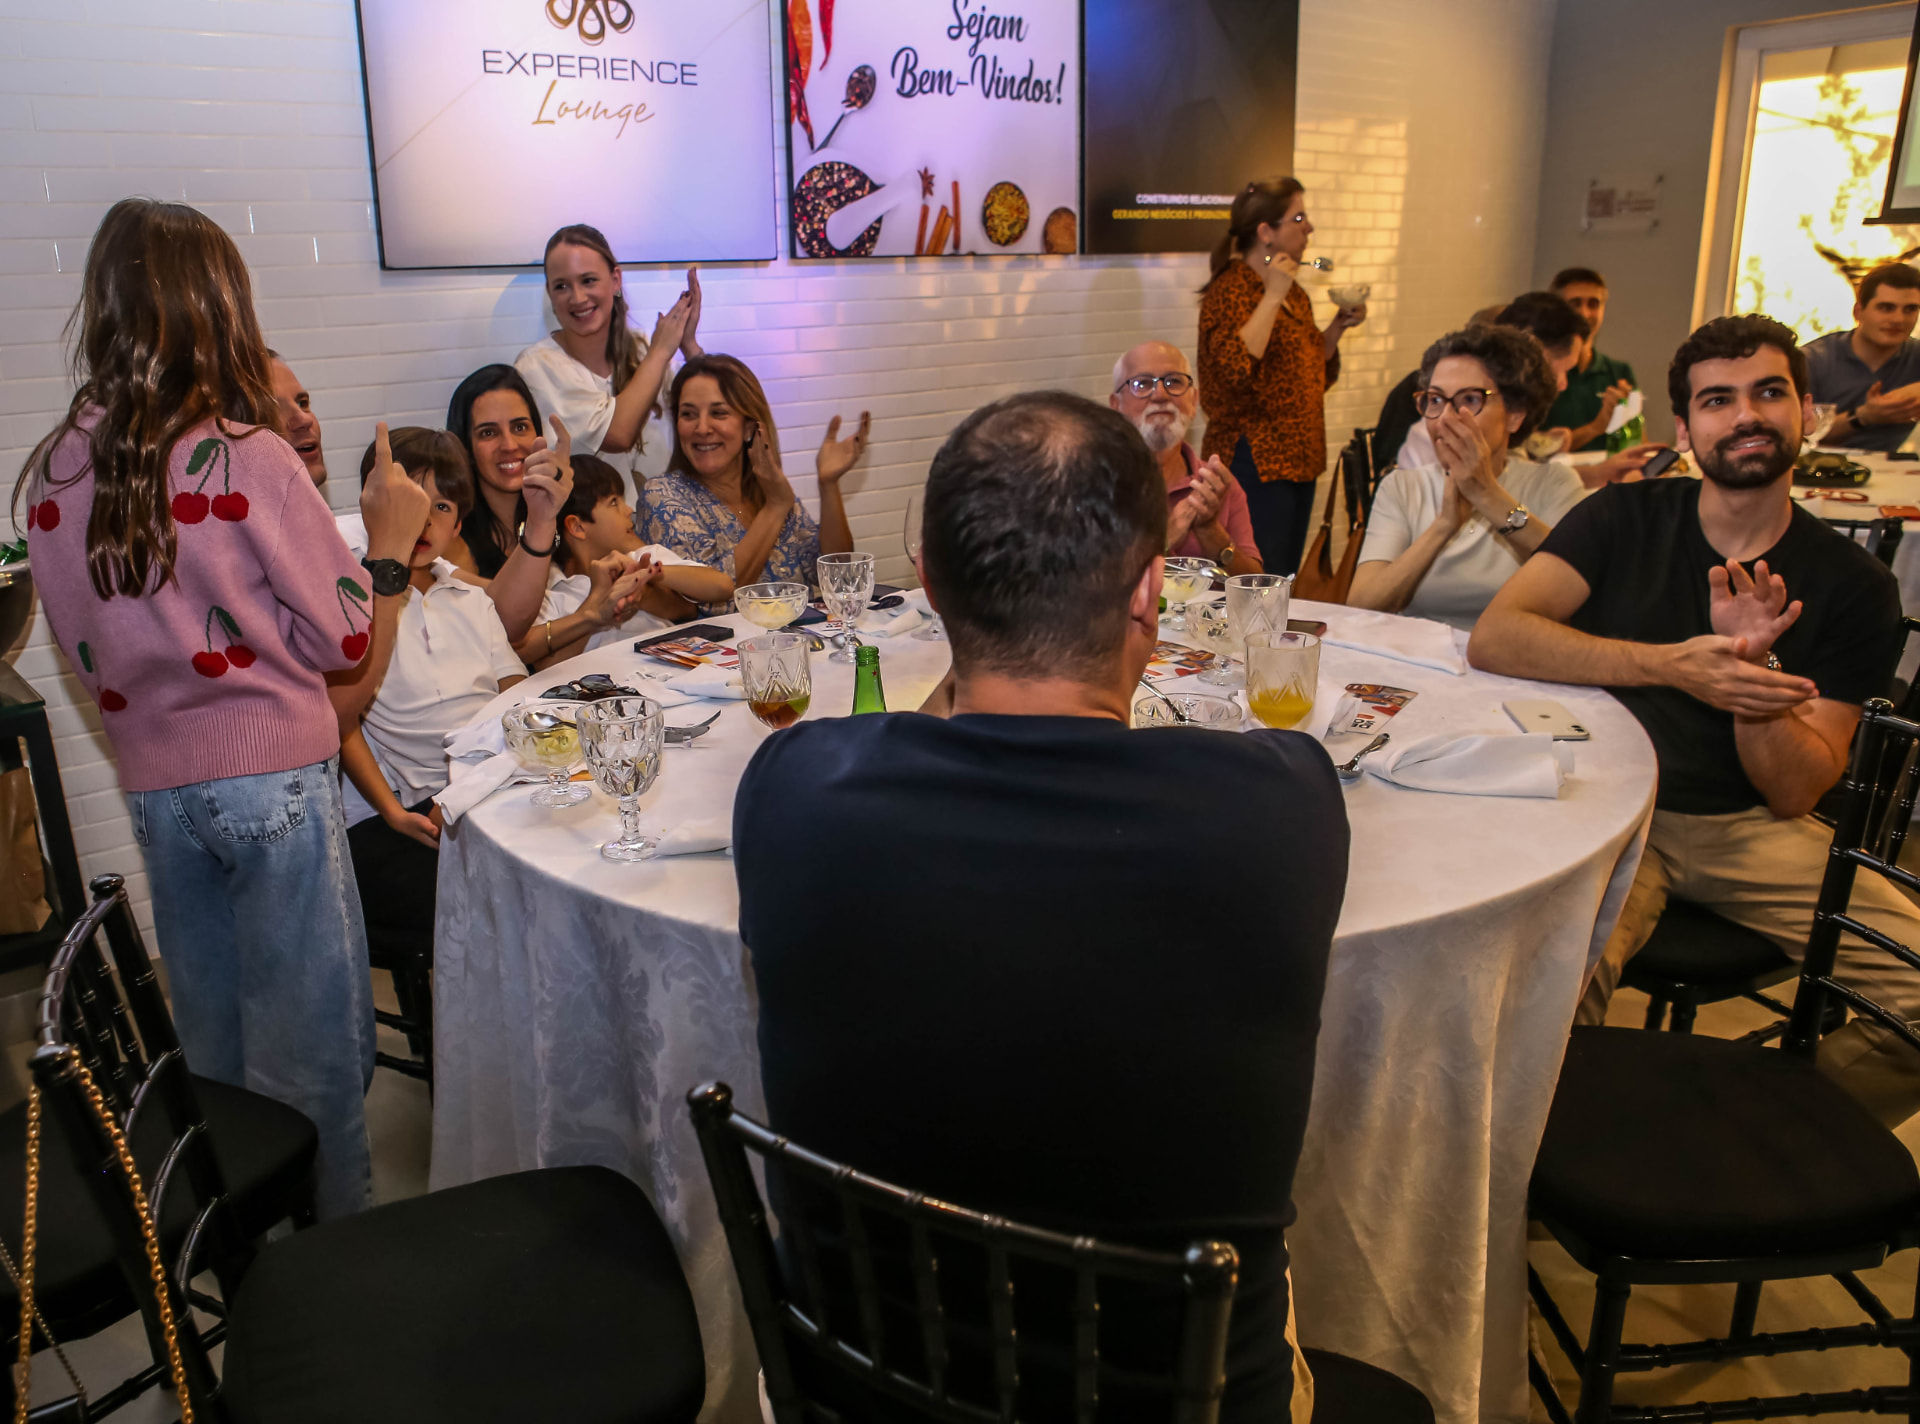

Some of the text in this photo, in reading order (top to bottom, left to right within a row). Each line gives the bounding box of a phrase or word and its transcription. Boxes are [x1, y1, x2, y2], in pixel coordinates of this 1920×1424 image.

[947, 0, 1030, 57] Sejam
[482, 50, 698, 86] EXPERIENCE
[890, 46, 1066, 105] Bem-Vindos!
[532, 79, 656, 140] Lounge
